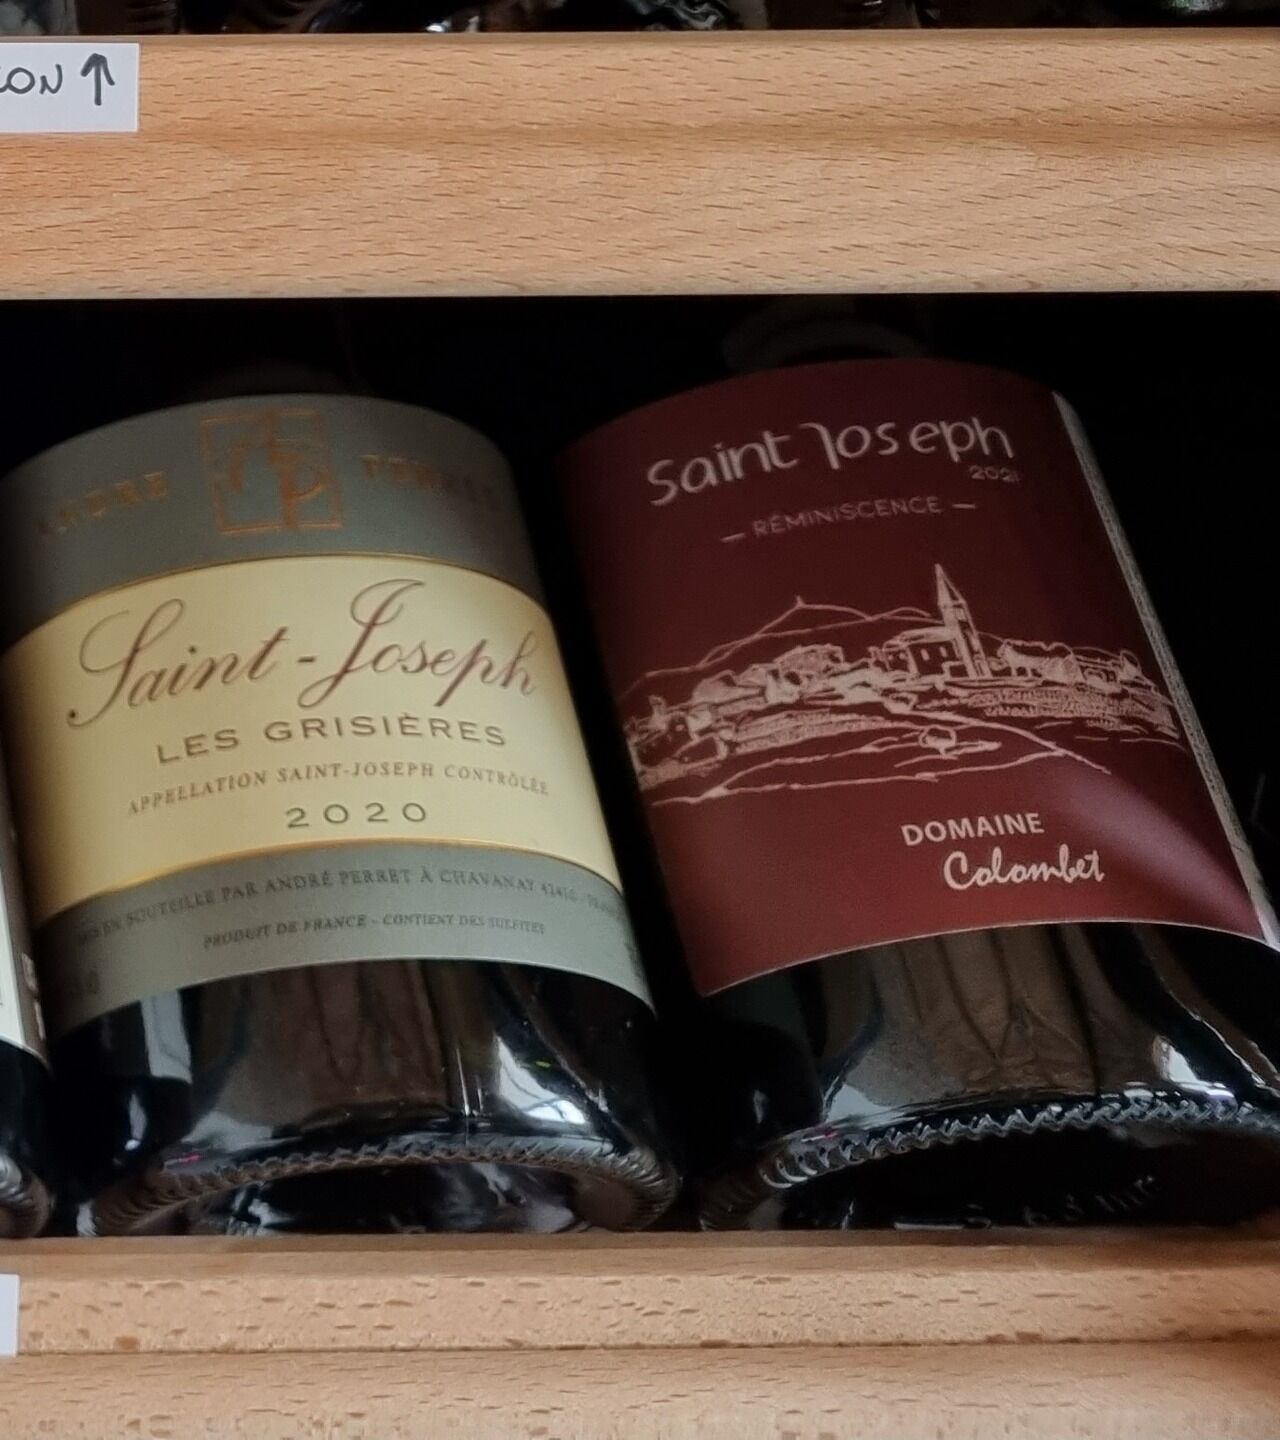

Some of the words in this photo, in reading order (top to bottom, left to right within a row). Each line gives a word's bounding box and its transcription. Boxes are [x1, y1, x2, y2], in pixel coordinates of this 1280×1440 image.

[647, 429, 801, 507] Saint
[801, 414, 1014, 472] Joseph
[156, 727, 241, 765] LES
[262, 712, 507, 748] GRISIÈRES
[127, 771, 268, 816] APPELLATION
[276, 761, 435, 784] SAINT-JOSEPH
[285, 802, 428, 829] 2020
[901, 812, 1045, 848] DOMAINE
[220, 881, 259, 903] PAR
[264, 869, 334, 894] ANDRÉ
[338, 867, 411, 887] PERRET
[439, 867, 536, 894] CHAVANAY
[202, 922, 271, 952] PRODUIT
[275, 918, 298, 935] DE
[303, 913, 368, 934] FRANCE
